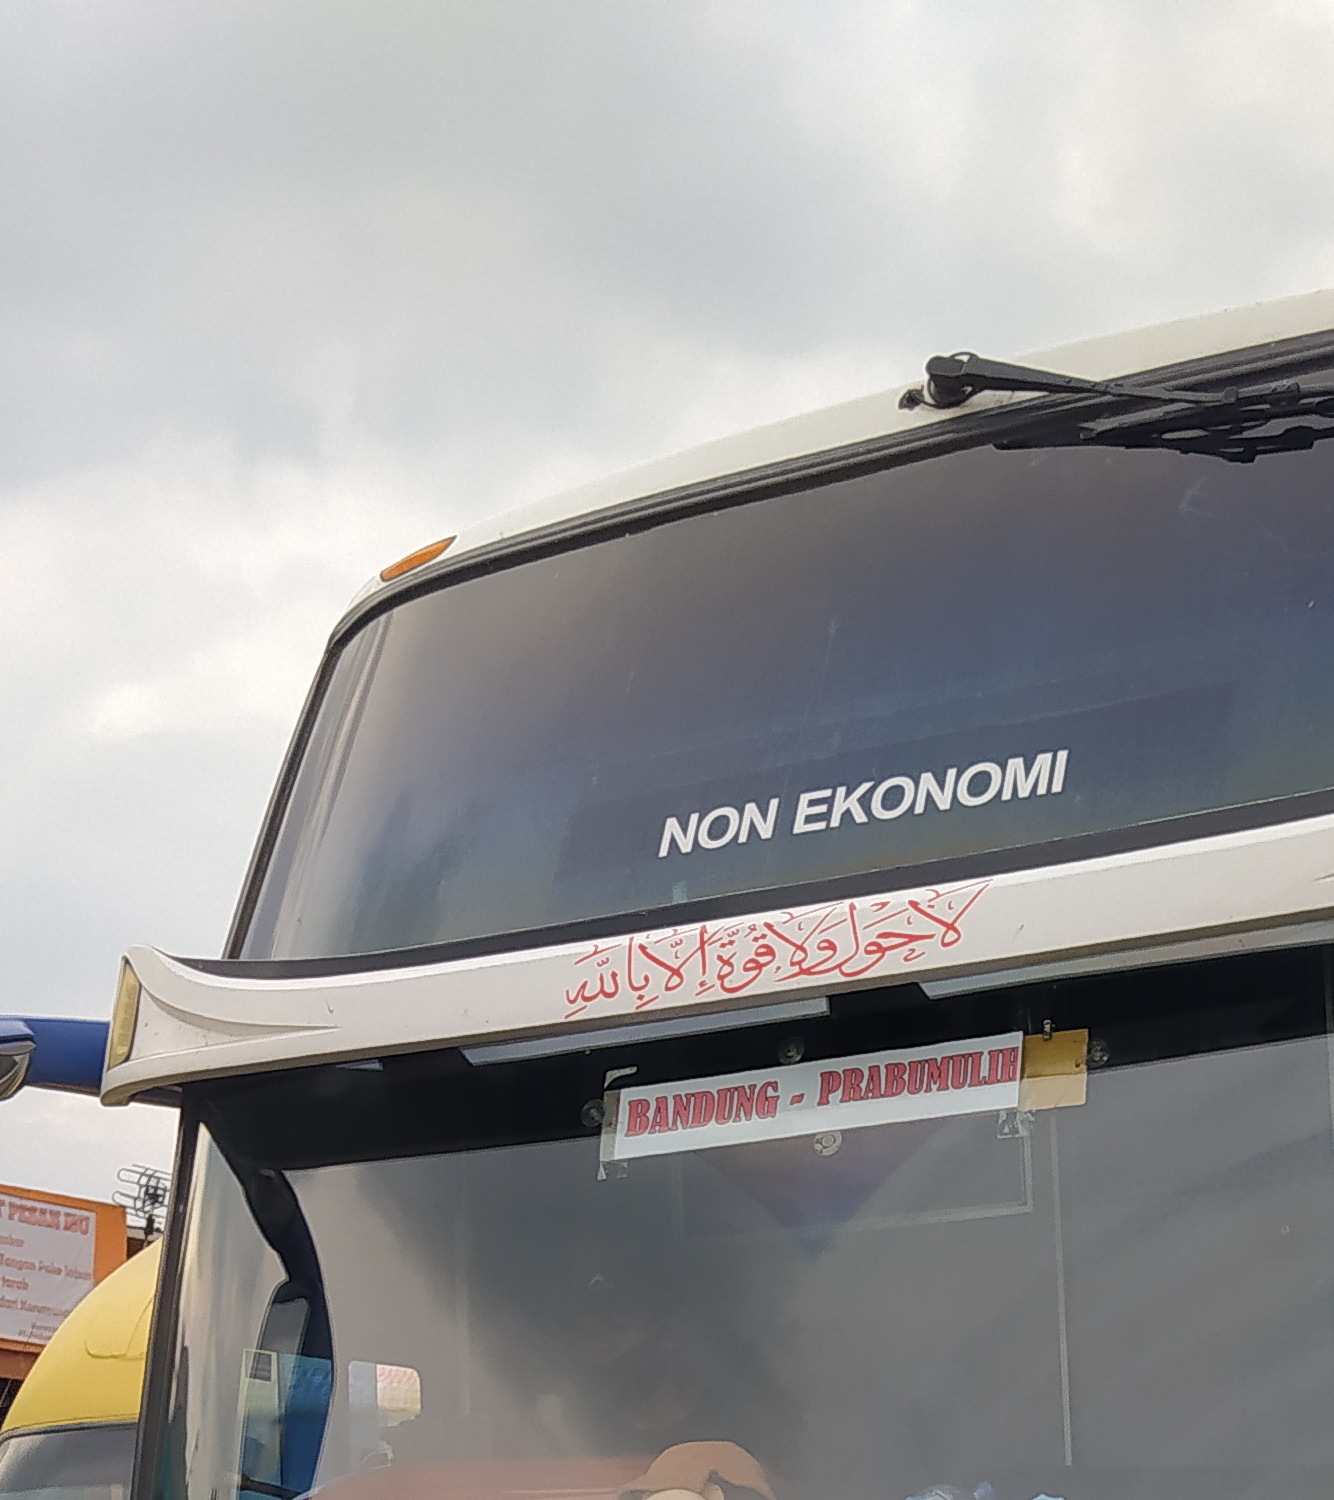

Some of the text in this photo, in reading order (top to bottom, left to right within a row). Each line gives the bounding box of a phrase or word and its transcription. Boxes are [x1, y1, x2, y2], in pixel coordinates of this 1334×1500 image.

[658, 749, 1070, 858] NON EKONOMI
[624, 1081, 780, 1138] BANDUNG
[818, 1045, 1021, 1106] PRABUMULIH
